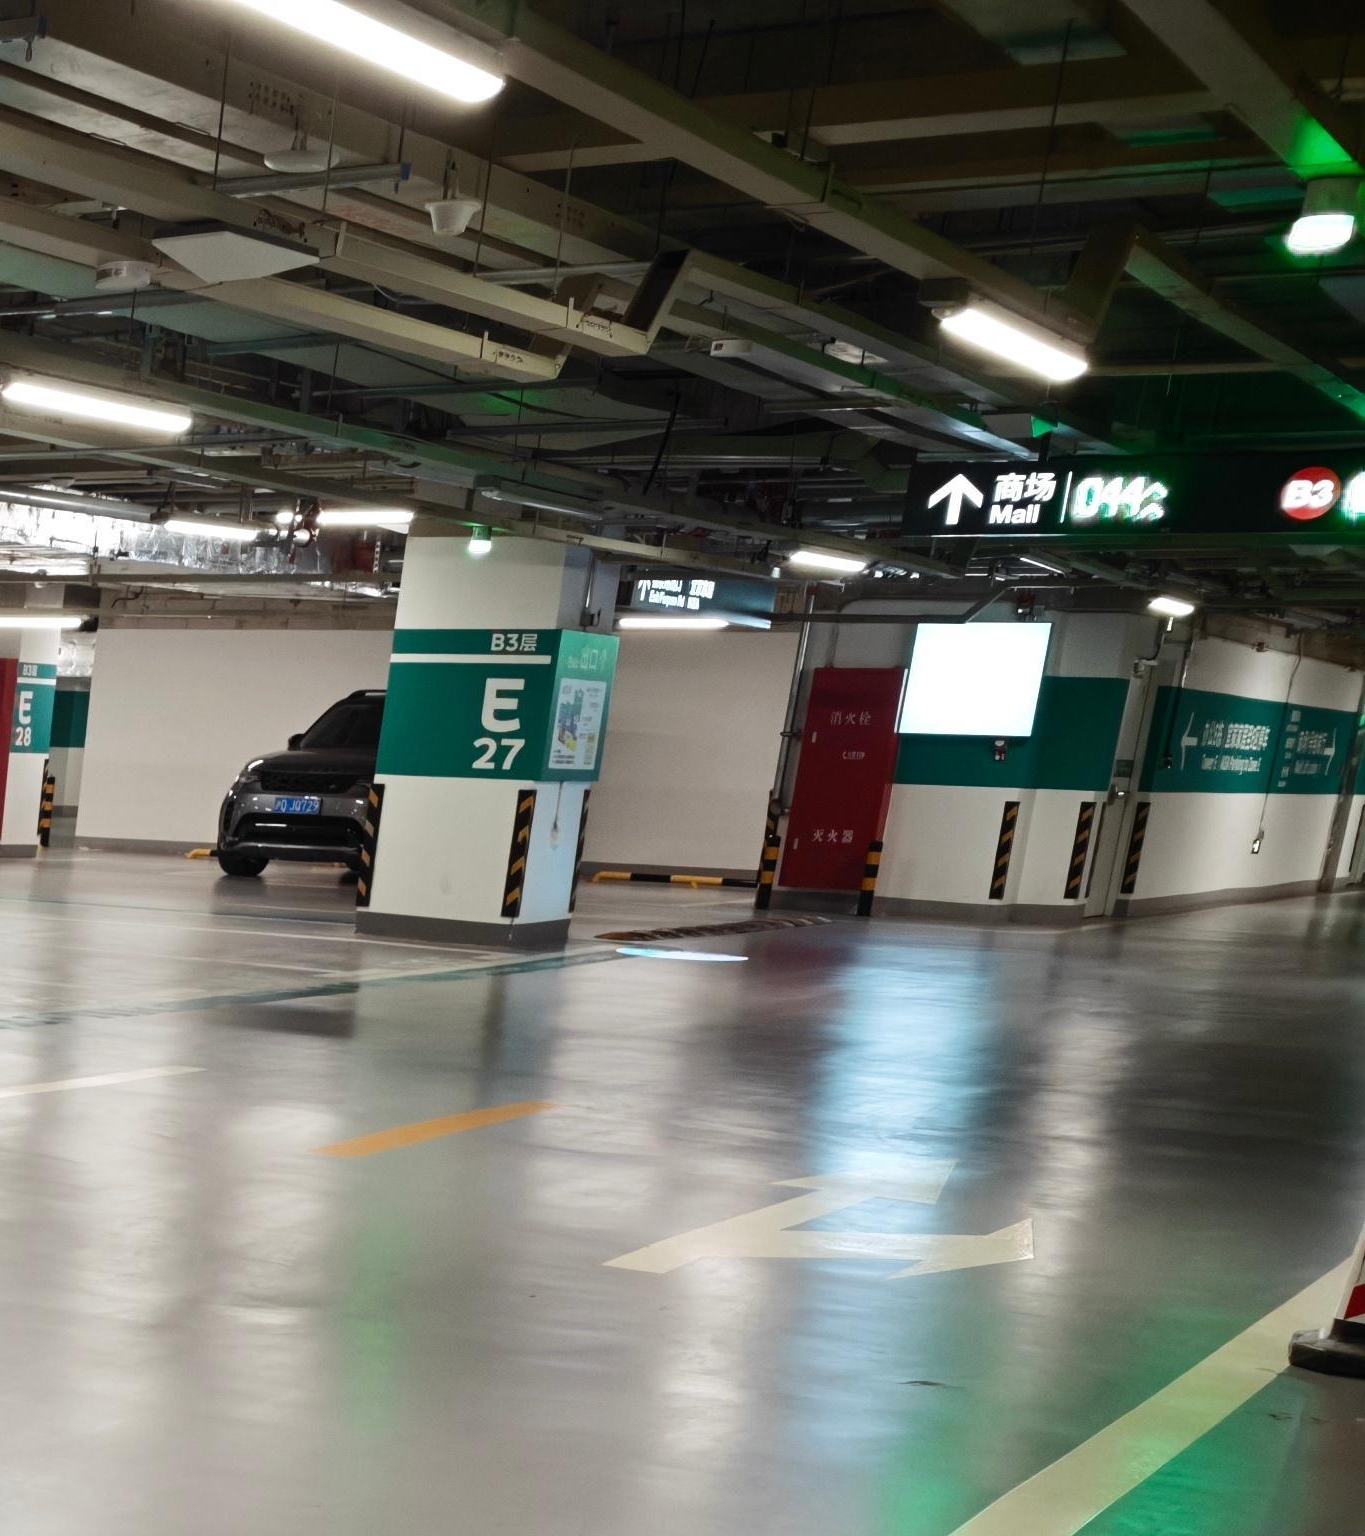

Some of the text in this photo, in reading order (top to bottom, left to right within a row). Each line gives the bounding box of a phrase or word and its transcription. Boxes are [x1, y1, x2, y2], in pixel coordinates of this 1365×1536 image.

[994, 472, 1057, 502] 商场
[1280, 479, 1335, 509] B3
[988, 503, 1041, 524] Mall
[490, 633, 538, 652] B3层
[18, 690, 34, 725] E
[480, 677, 526, 733] E
[830, 710, 872, 726] 消火栓
[15, 727, 32, 746] 28
[471, 736, 526, 771] 27
[812, 828, 855, 844] 灭火器
